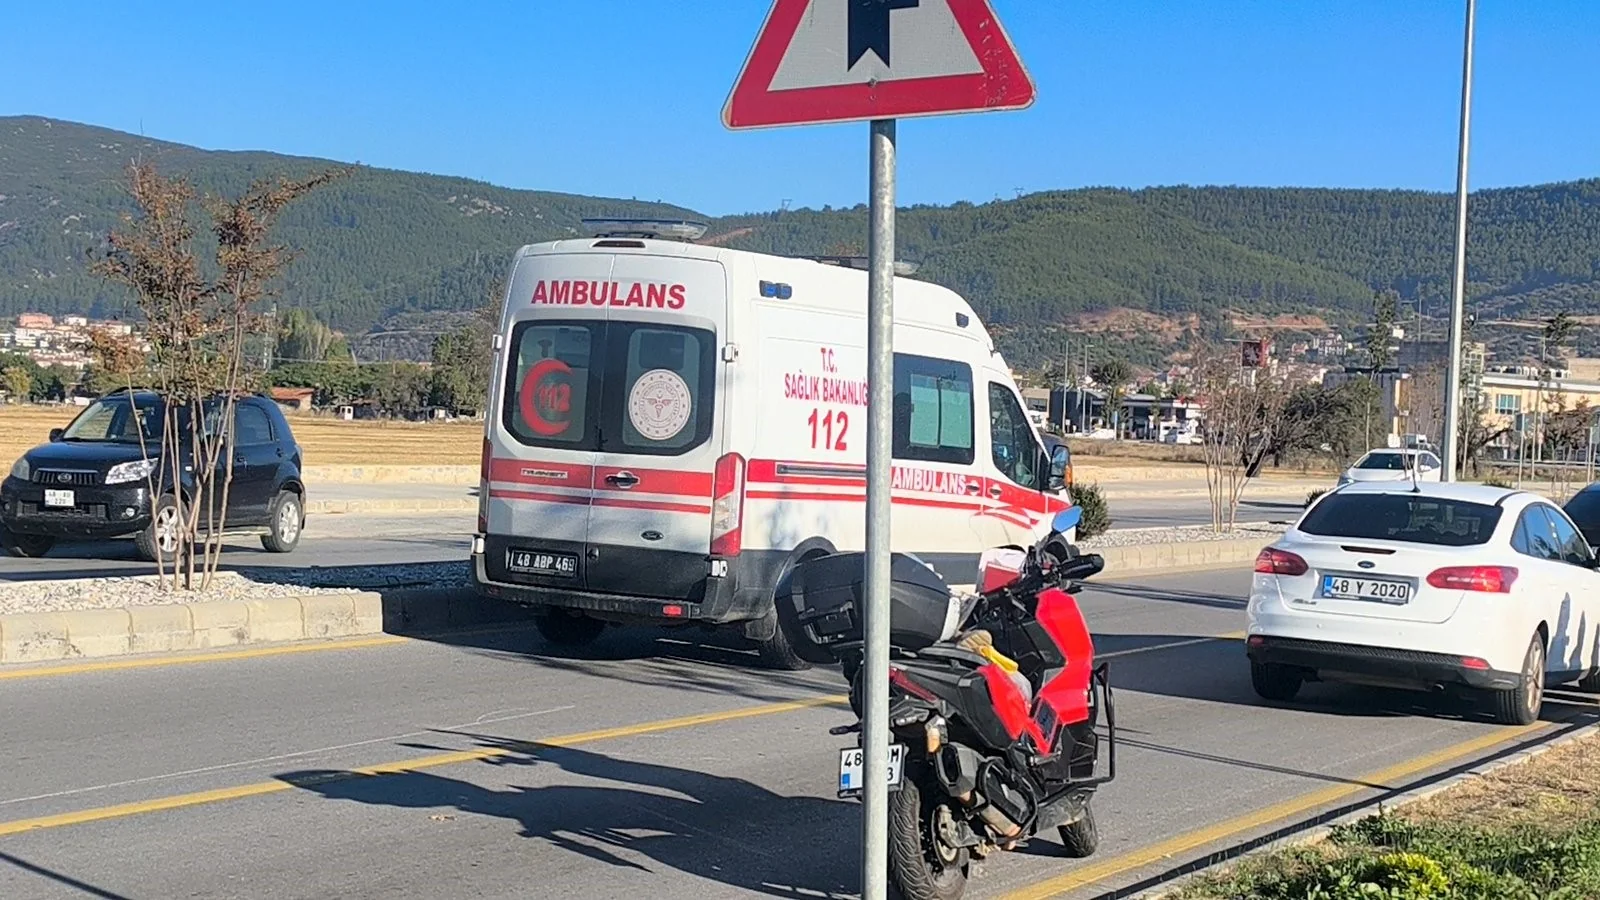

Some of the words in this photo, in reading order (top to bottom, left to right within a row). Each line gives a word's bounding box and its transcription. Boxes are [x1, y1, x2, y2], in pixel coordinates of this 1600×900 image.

[531, 280, 686, 309] AMBULANS
[821, 347, 838, 373] T.C.
[538, 383, 571, 412] 112
[784, 368, 820, 400] SAĞLIK
[823, 376, 870, 406] BAKANLIĞ
[808, 407, 849, 451] 112
[892, 466, 967, 495] AMBULANS
[517, 553, 531, 567] 48
[533, 554, 553, 569] ABP
[555, 556, 575, 572] 469
[1331, 579, 1349, 593] 48
[1356, 581, 1364, 594] Y
[1370, 582, 1406, 598] 2020
[844, 752, 863, 767] 48
[887, 748, 899, 763] M
